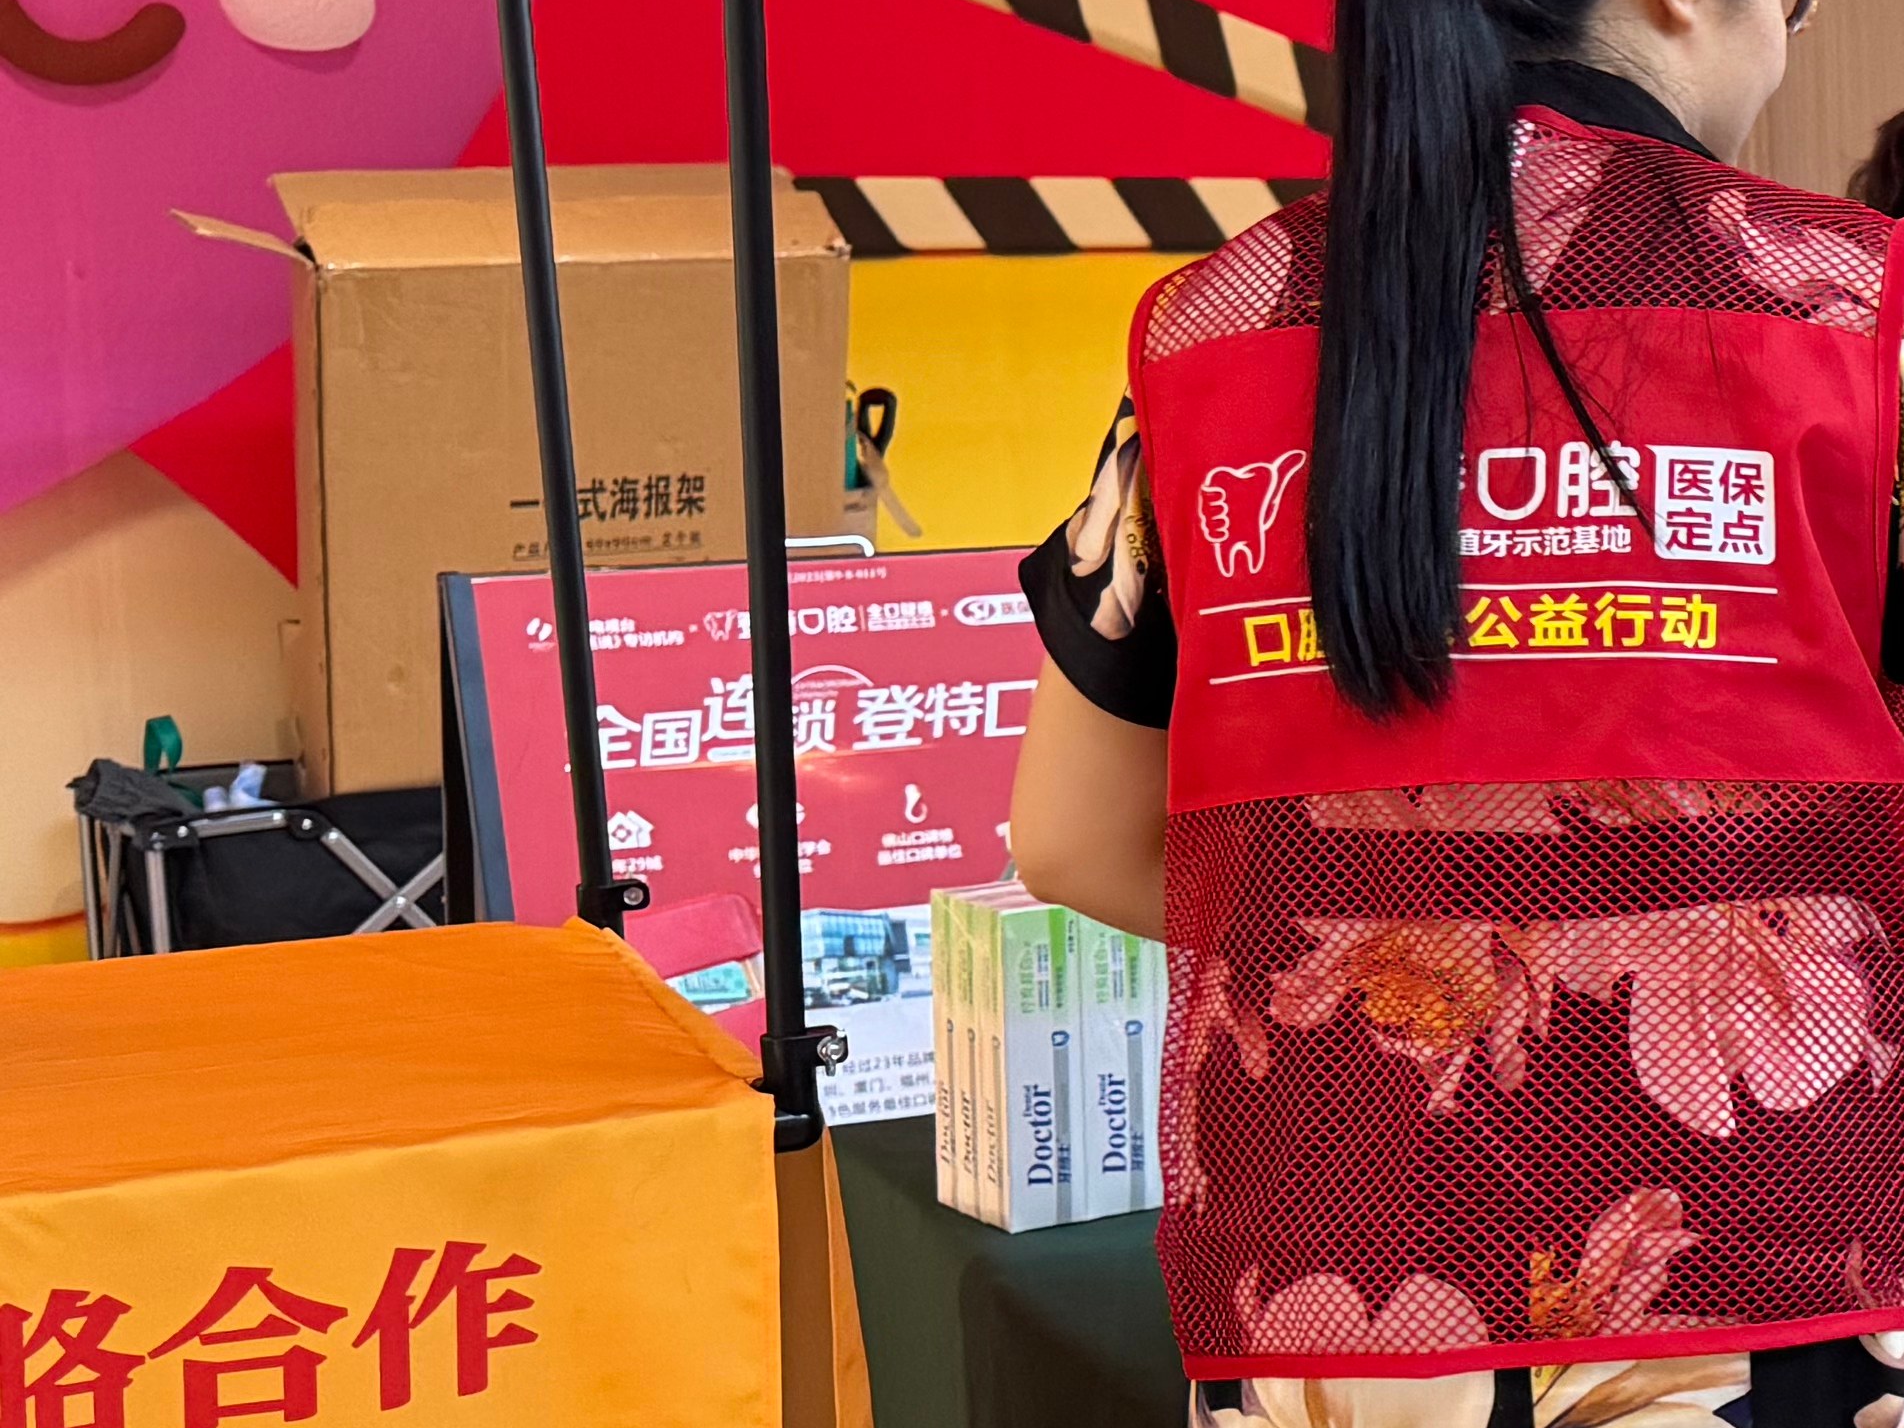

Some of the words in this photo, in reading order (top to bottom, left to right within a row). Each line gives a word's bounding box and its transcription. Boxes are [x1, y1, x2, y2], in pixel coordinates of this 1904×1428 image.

[510, 473, 705, 522] 一式海报架
[1668, 459, 1766, 506] 医保
[1666, 507, 1765, 555] 定点
[1243, 591, 1718, 667] 口公益行动
[1027, 1084, 1053, 1187] Doctor
[1102, 1073, 1127, 1174] Doctor
